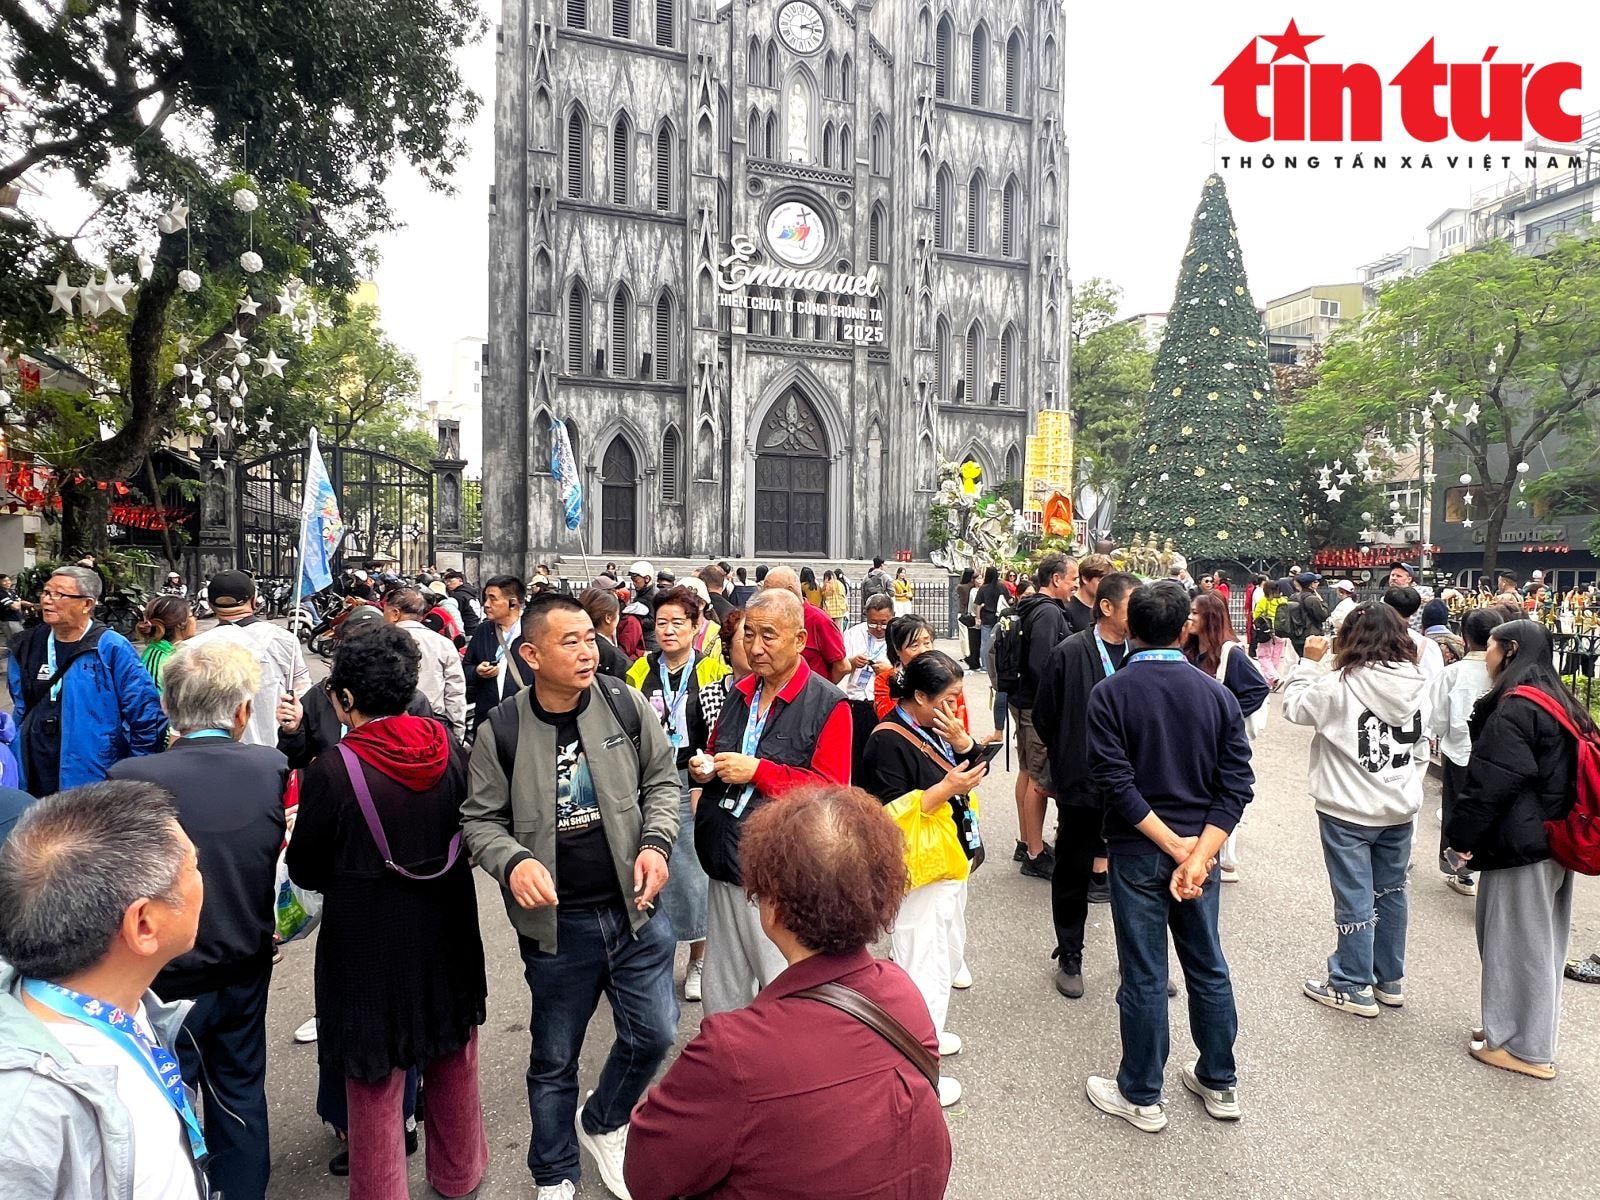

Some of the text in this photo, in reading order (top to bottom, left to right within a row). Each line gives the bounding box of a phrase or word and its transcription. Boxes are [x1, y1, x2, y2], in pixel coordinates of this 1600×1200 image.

[718, 234, 879, 298] Emmanuel
[869, 308, 883, 321] TA
[843, 324, 884, 342] 2025
[570, 814, 590, 826] SHUI
